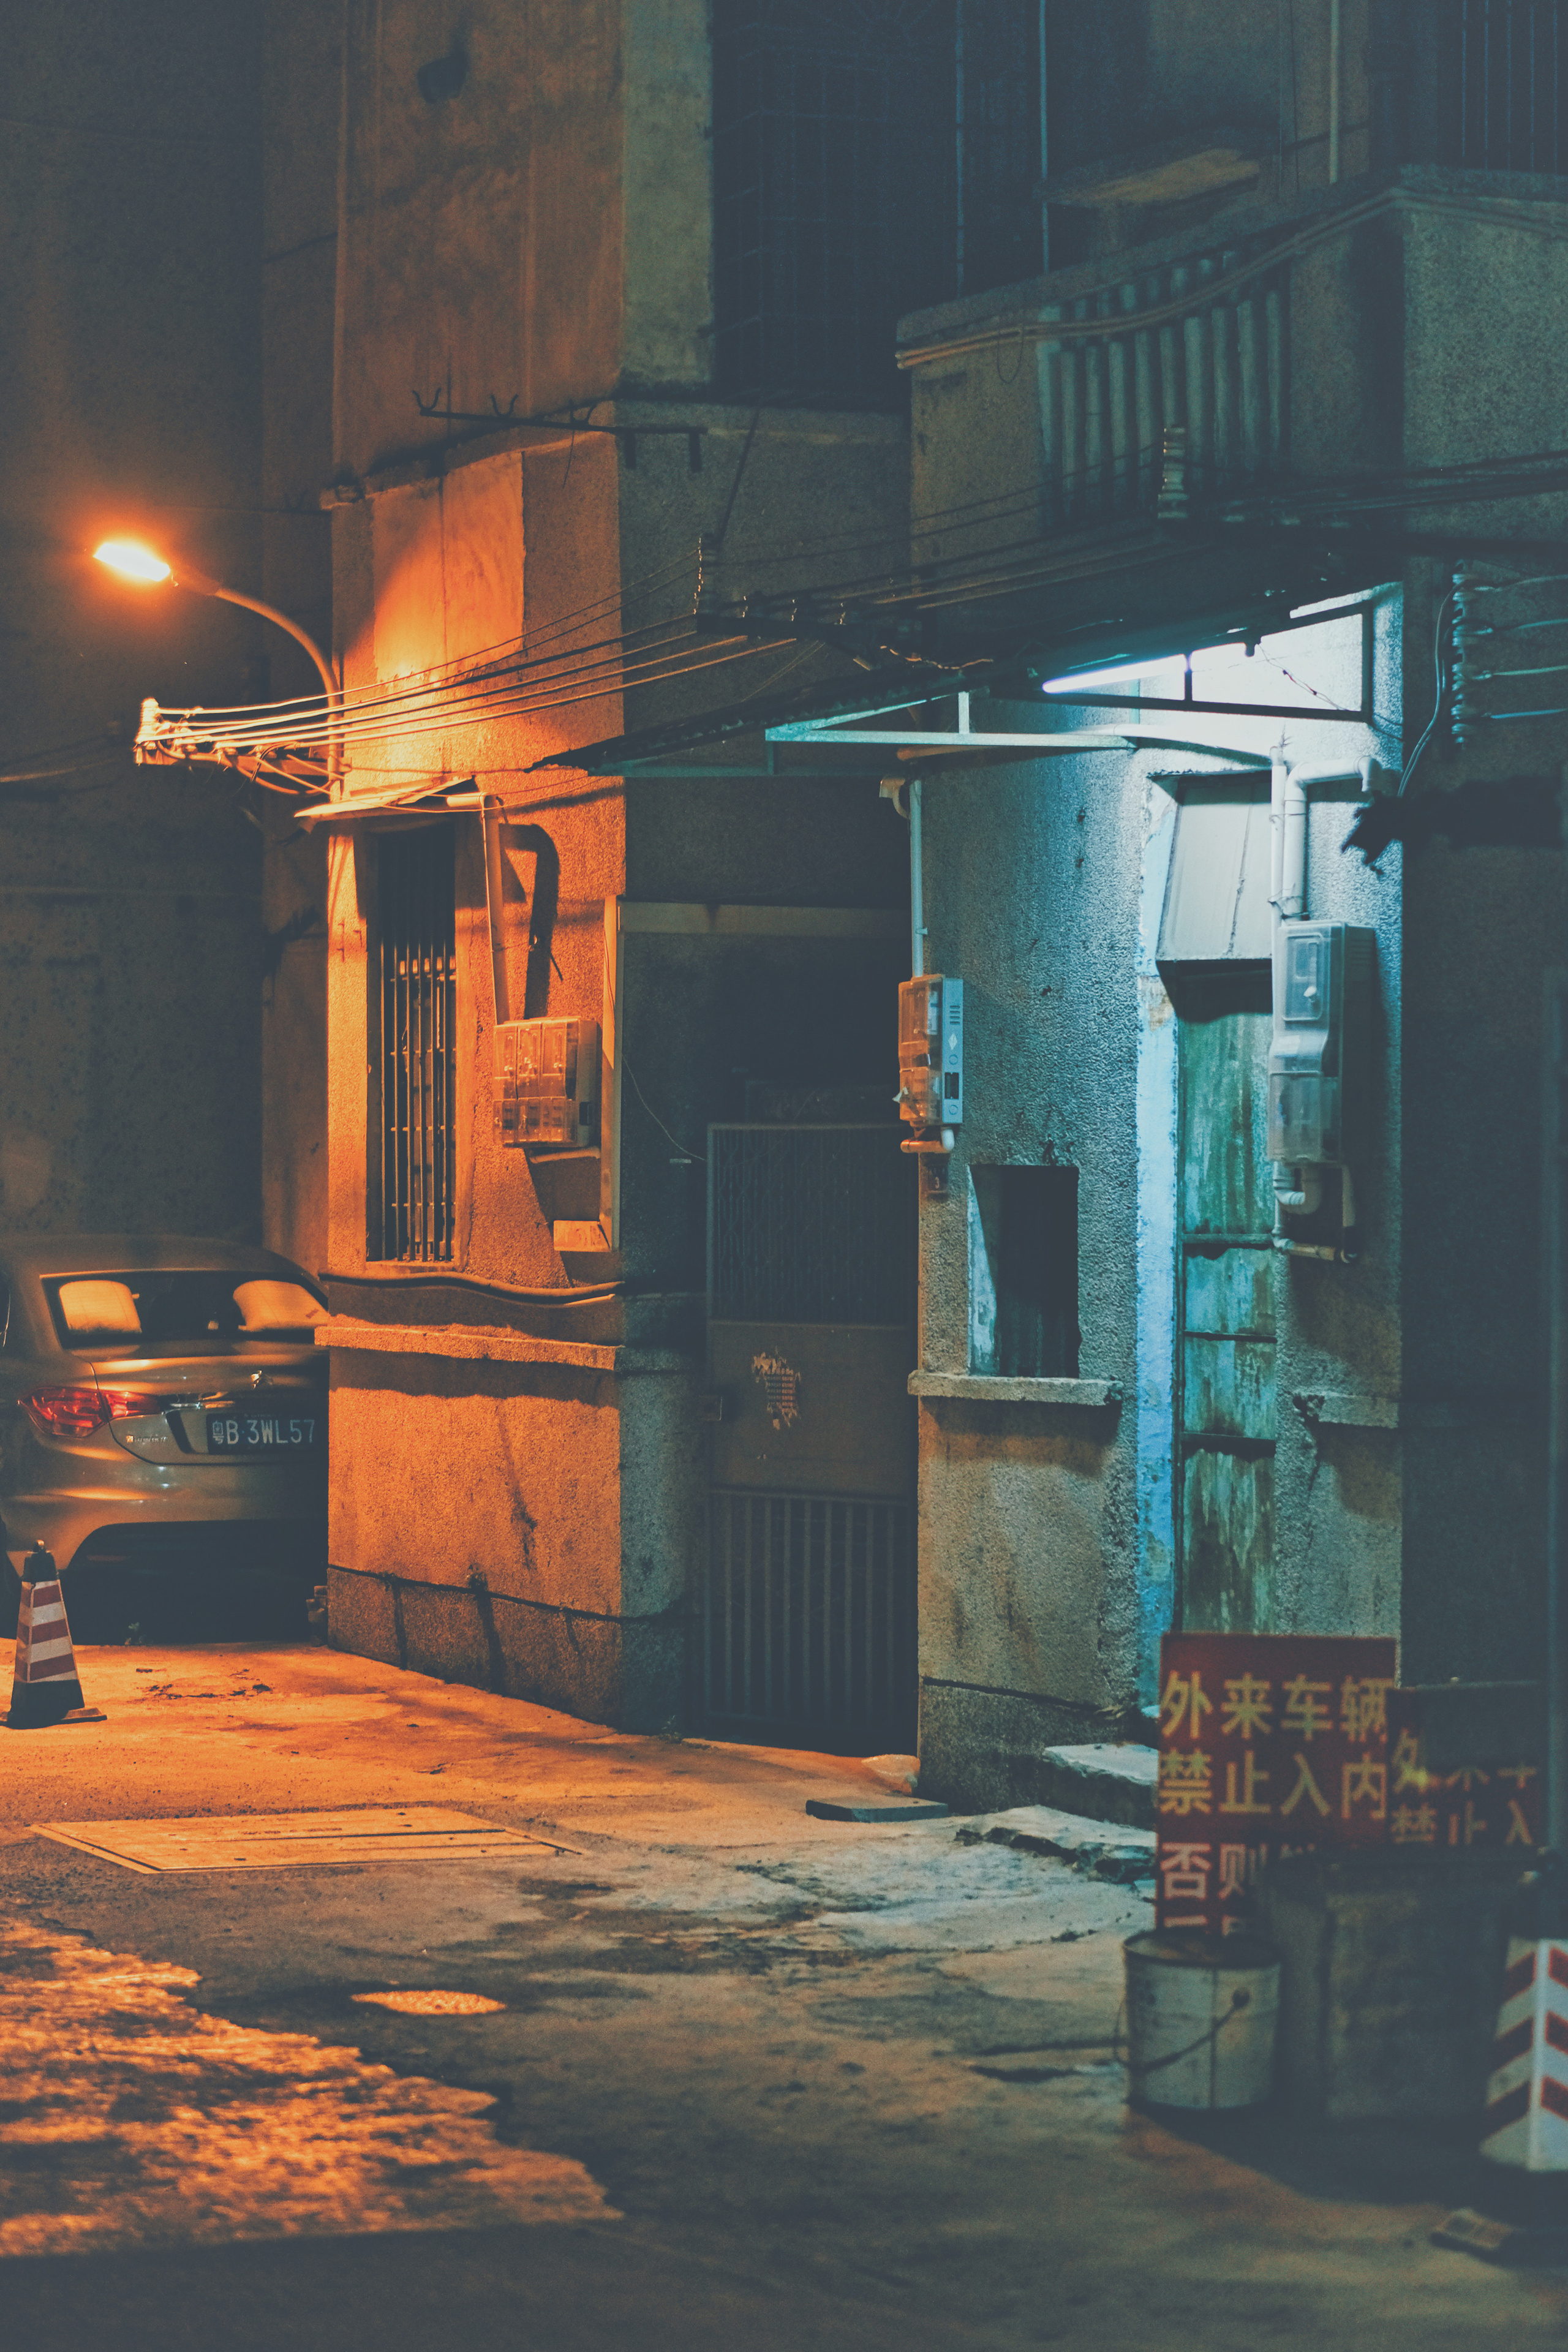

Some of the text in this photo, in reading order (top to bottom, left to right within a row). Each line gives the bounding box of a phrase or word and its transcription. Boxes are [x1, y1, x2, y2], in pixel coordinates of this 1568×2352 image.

[1161, 1670, 1394, 1743] 外来车辆
[1159, 1747, 1387, 1820] 禁止入内
[1160, 1842, 1315, 1900] 否则
